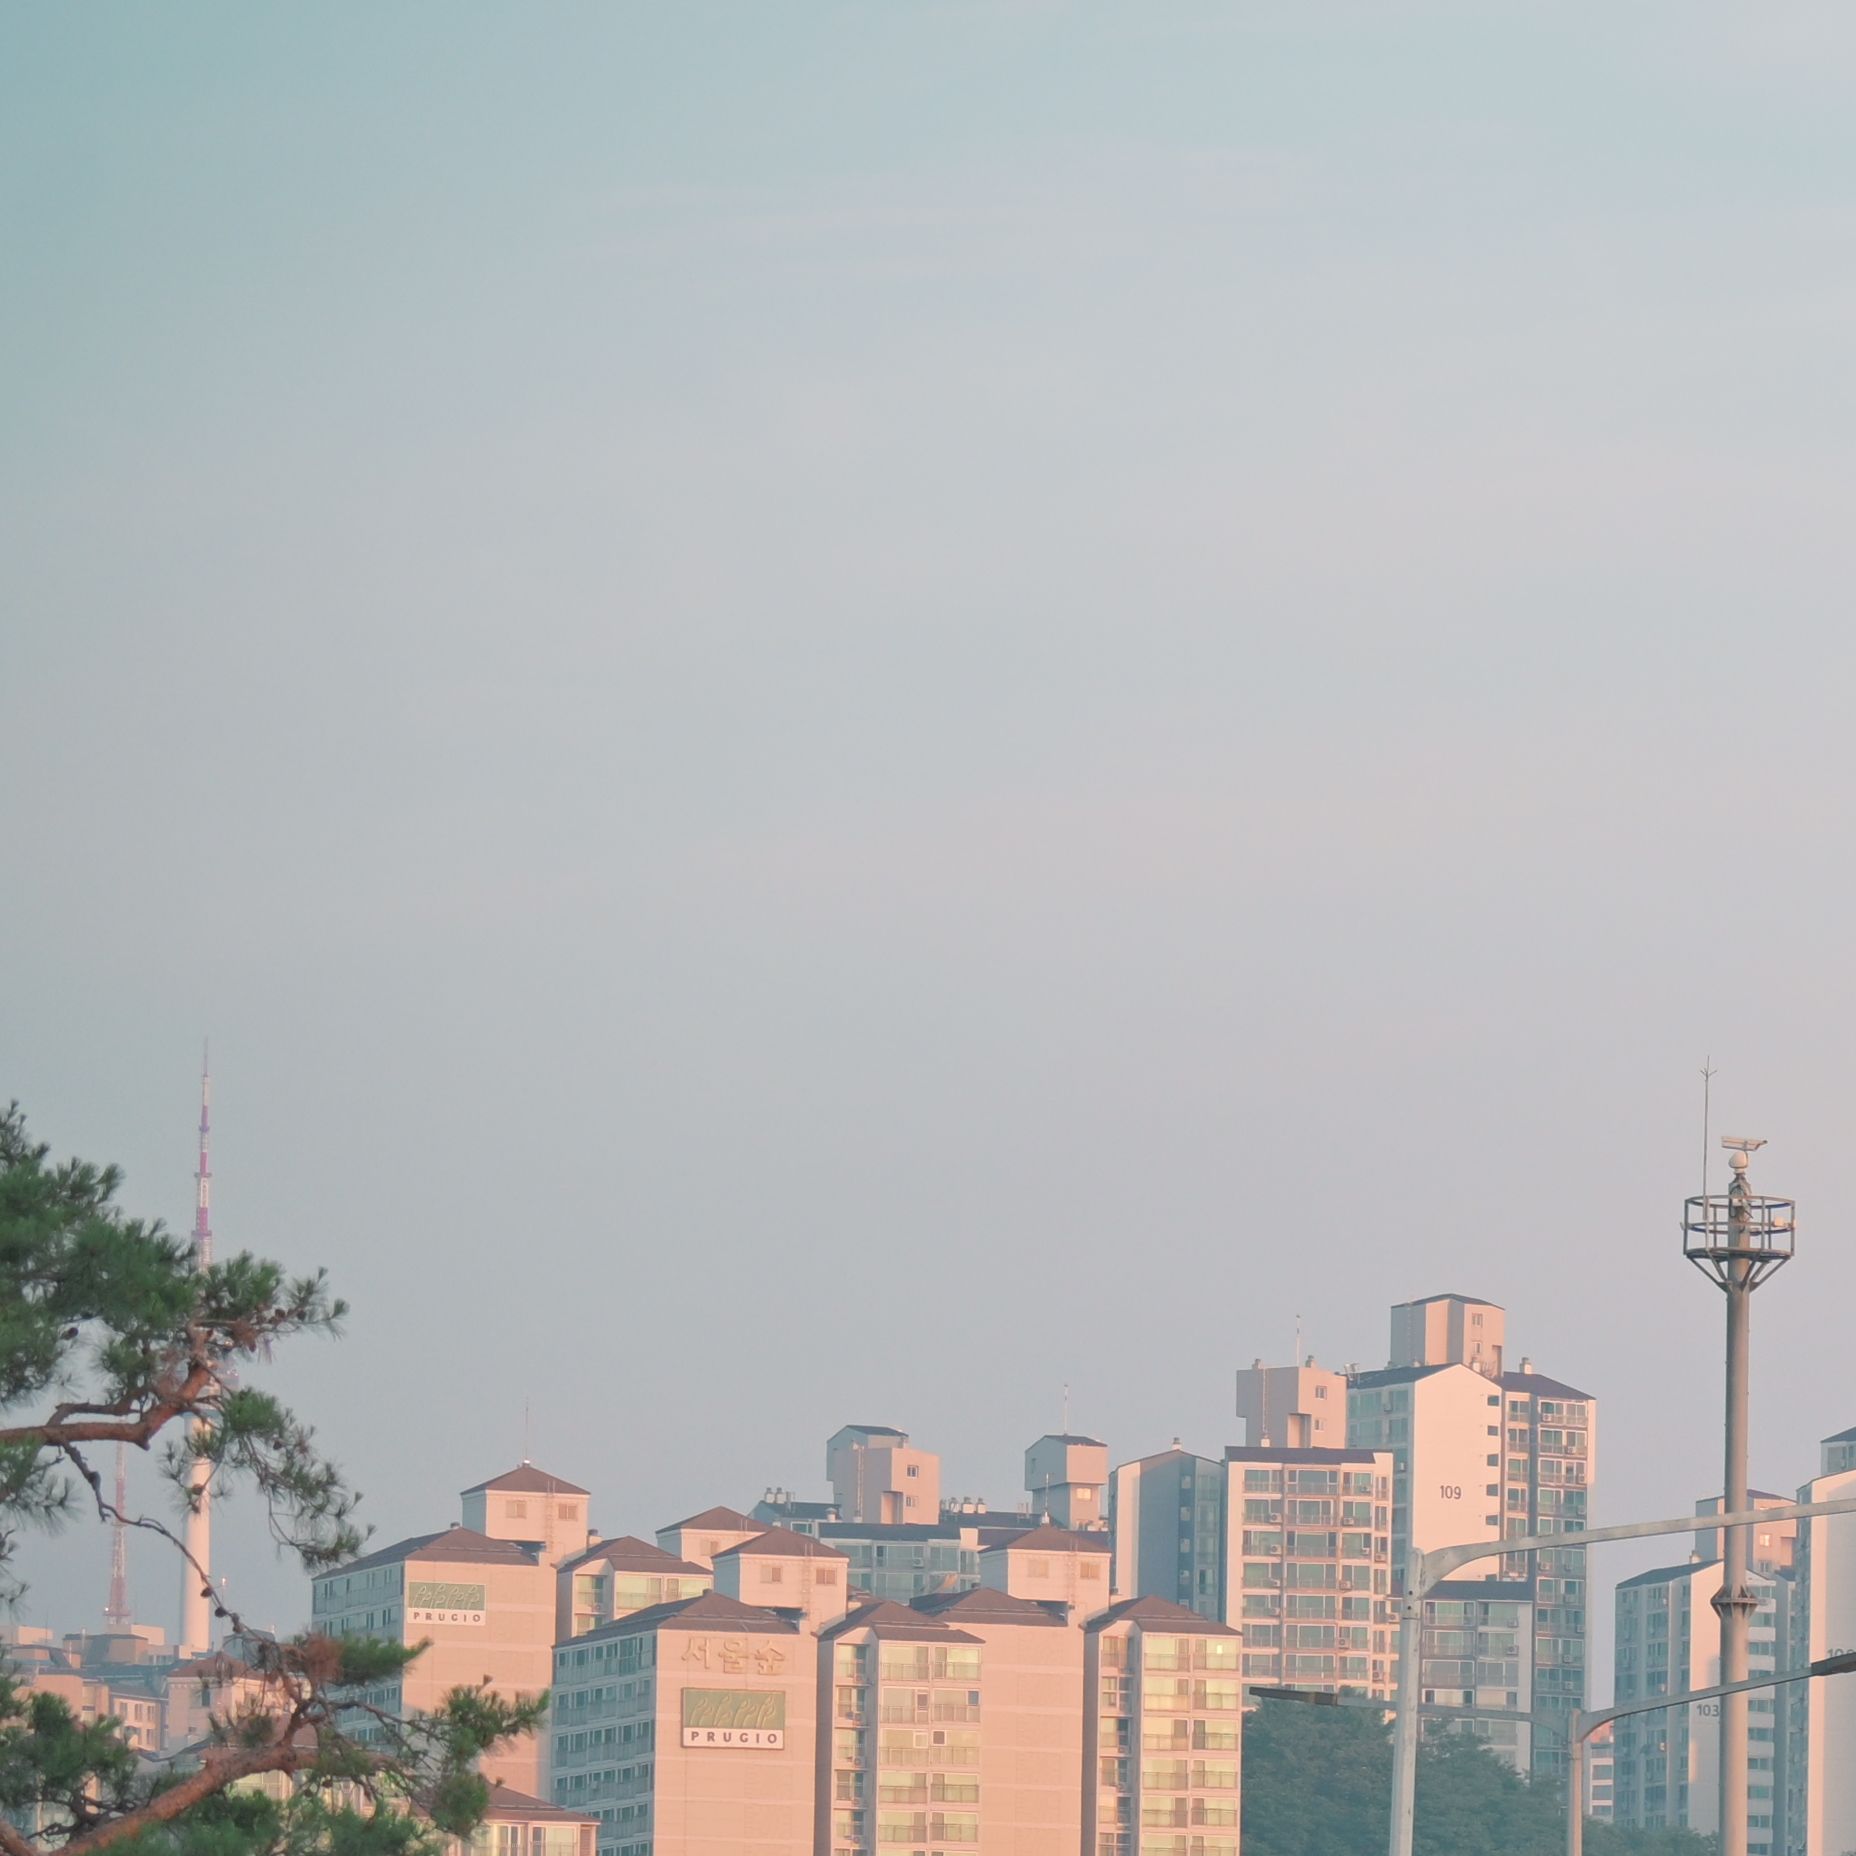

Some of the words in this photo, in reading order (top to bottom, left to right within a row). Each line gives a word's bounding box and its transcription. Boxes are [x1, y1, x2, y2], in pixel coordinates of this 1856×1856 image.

[1440, 1484, 1462, 1499] 109
[413, 1612, 481, 1622] PRUGIO
[681, 1637, 785, 1676] 서울숲
[1696, 1703, 1720, 1717] 103
[691, 1731, 778, 1744] PRUGIO
